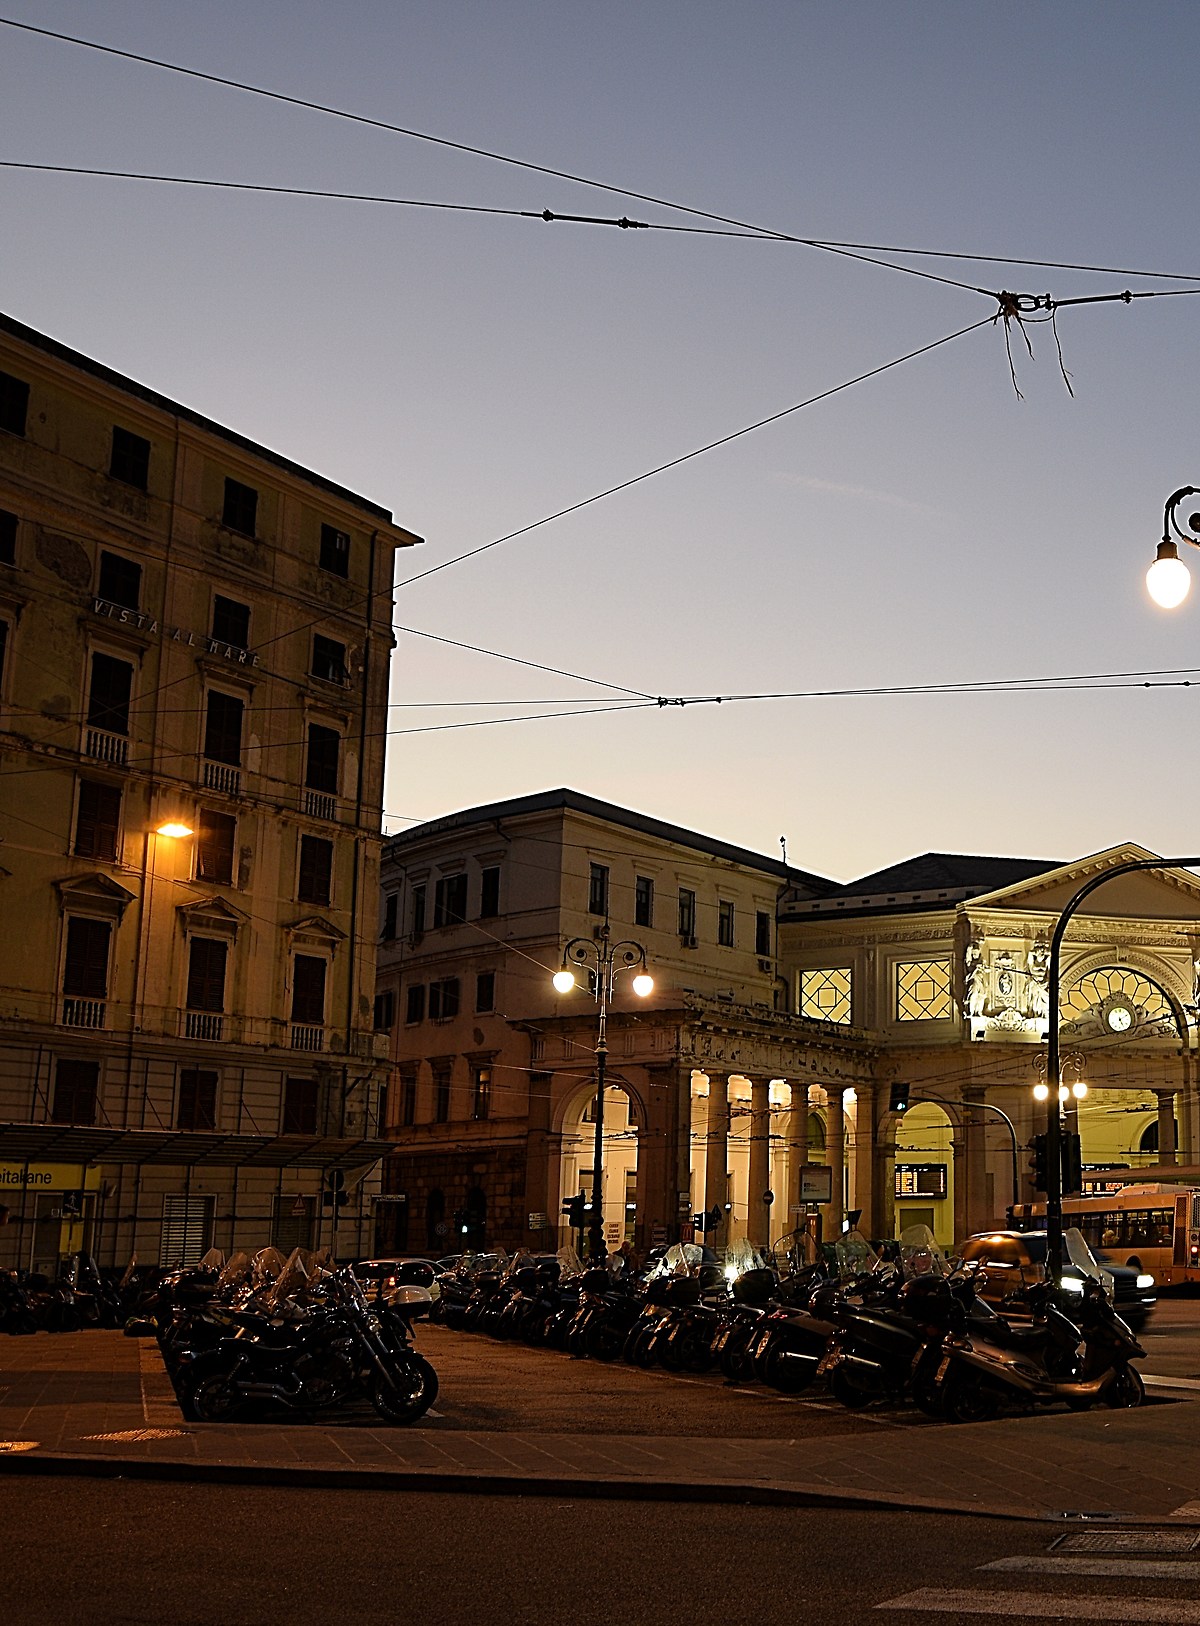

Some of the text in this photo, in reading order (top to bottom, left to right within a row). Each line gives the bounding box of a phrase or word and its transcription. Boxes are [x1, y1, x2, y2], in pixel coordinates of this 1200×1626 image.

[94, 600, 261, 668] VISTA AL MARE
